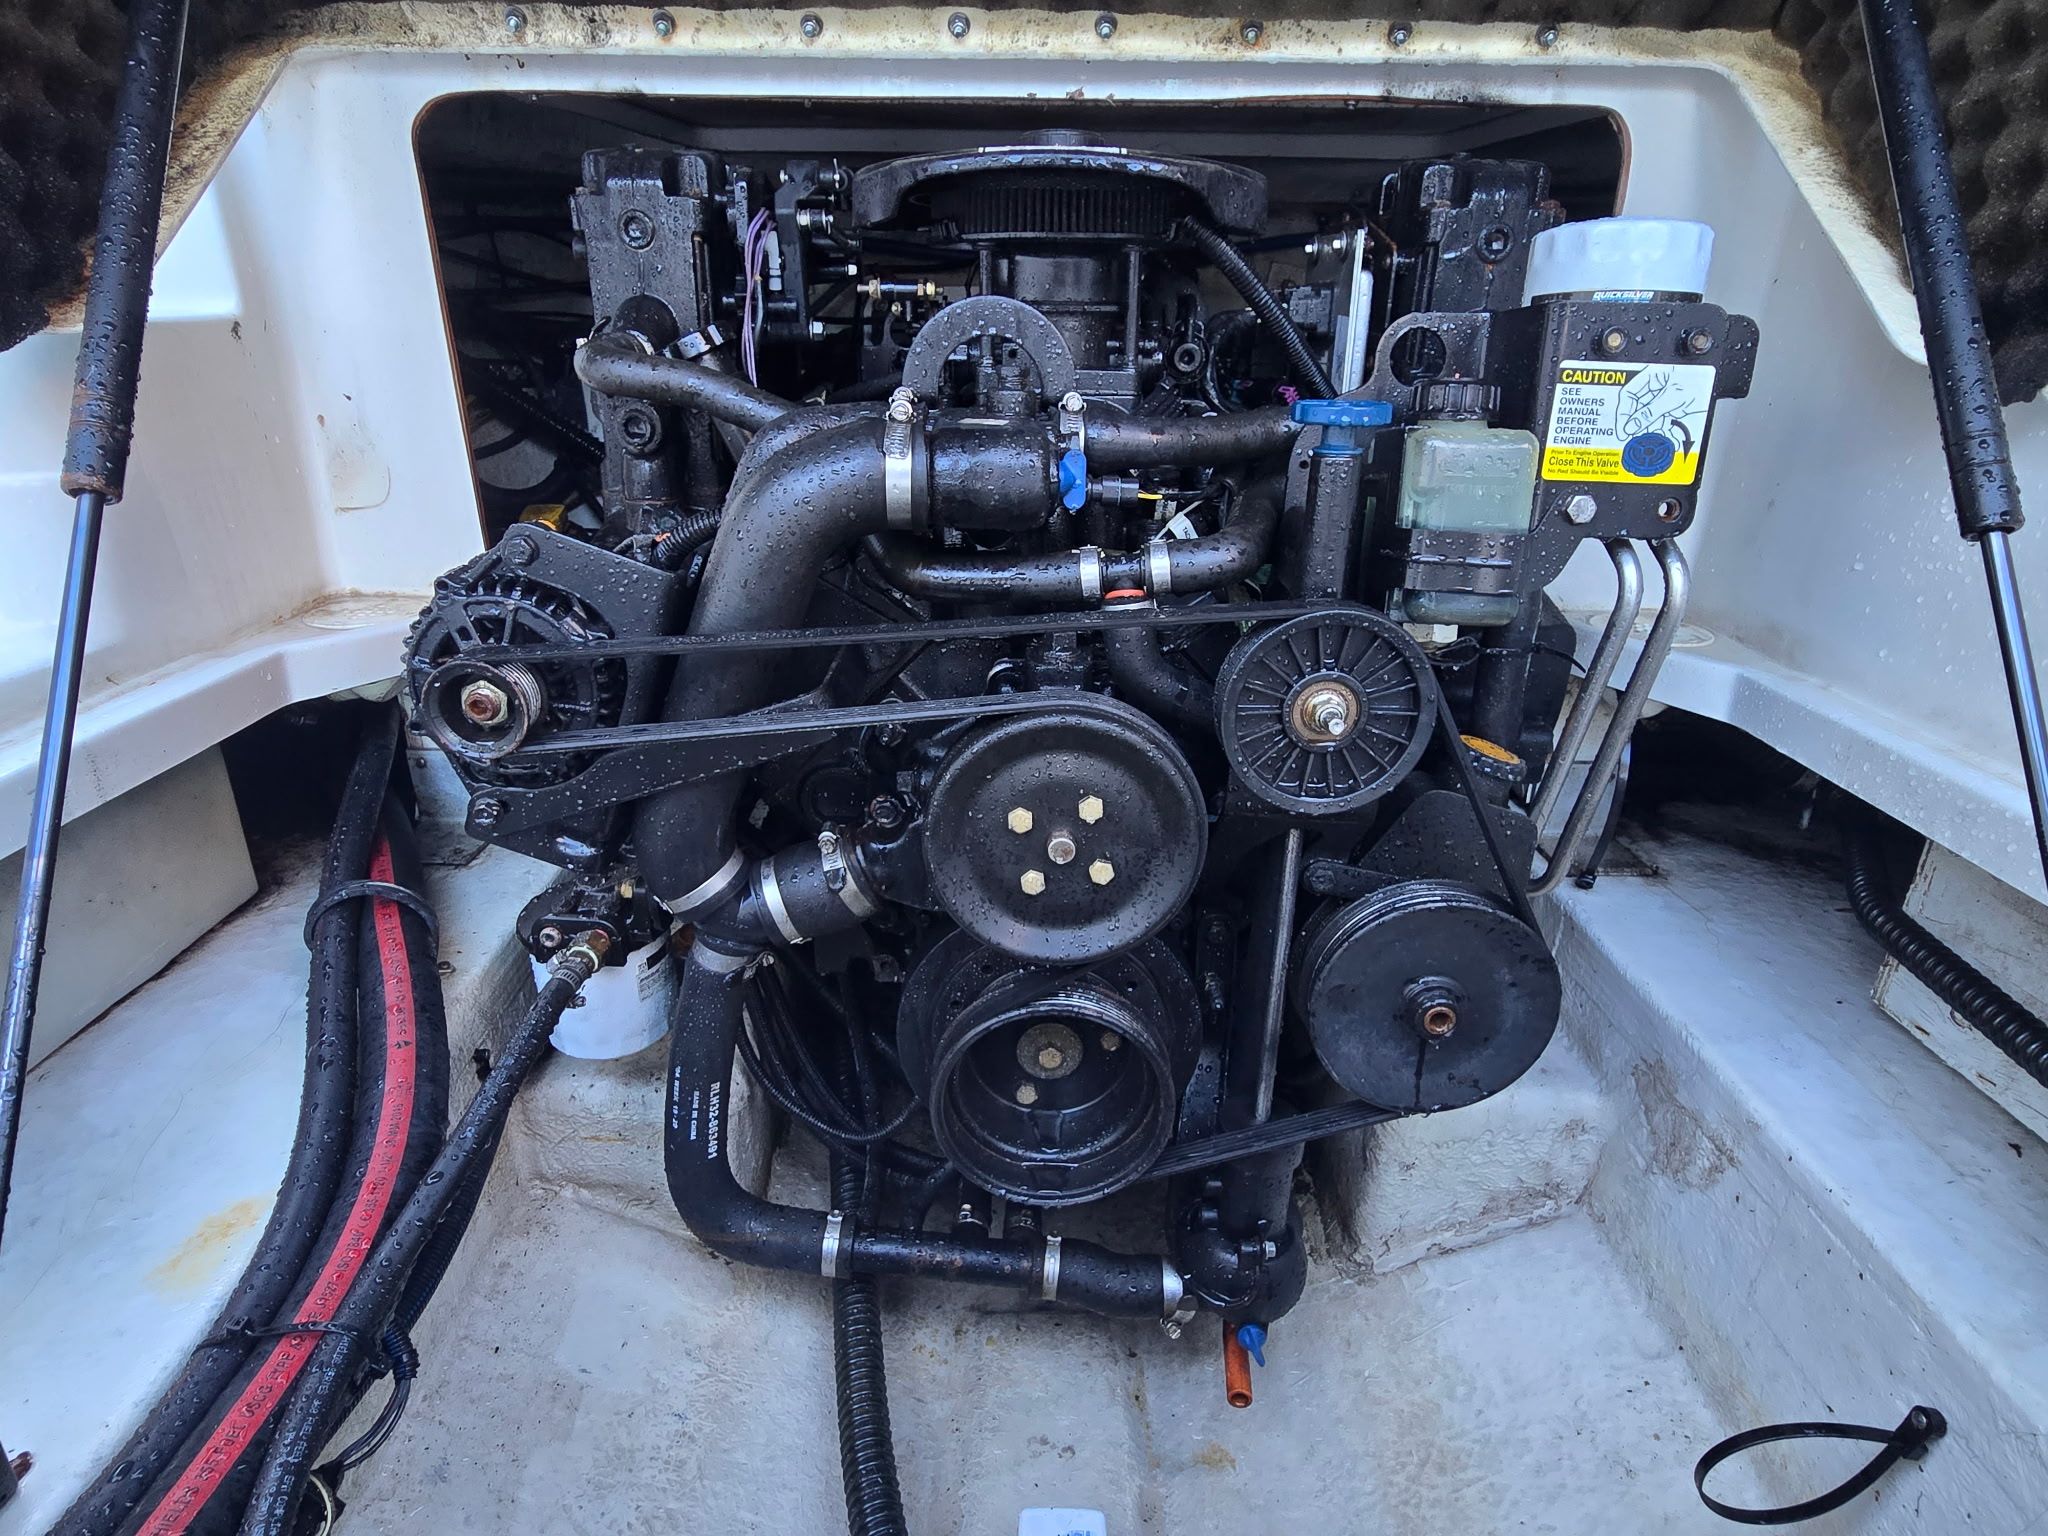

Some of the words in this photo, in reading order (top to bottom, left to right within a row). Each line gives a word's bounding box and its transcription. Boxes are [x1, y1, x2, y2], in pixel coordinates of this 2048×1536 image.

[1592, 291, 1654, 301] QUICKSILVER
[1562, 369, 1627, 384] CAUTION
[1561, 387, 1582, 396] SEE
[1559, 397, 1605, 407] OWNERS
[1558, 407, 1601, 416] MANUAL
[1556, 416, 1598, 426] BEFORE
[1554, 426, 1614, 436] OPERATING
[1553, 436, 1592, 445] ENGINE
[1548, 456, 1574, 466] Close
[1576, 457, 1594, 467] This
[1596, 458, 1619, 468] Valve
